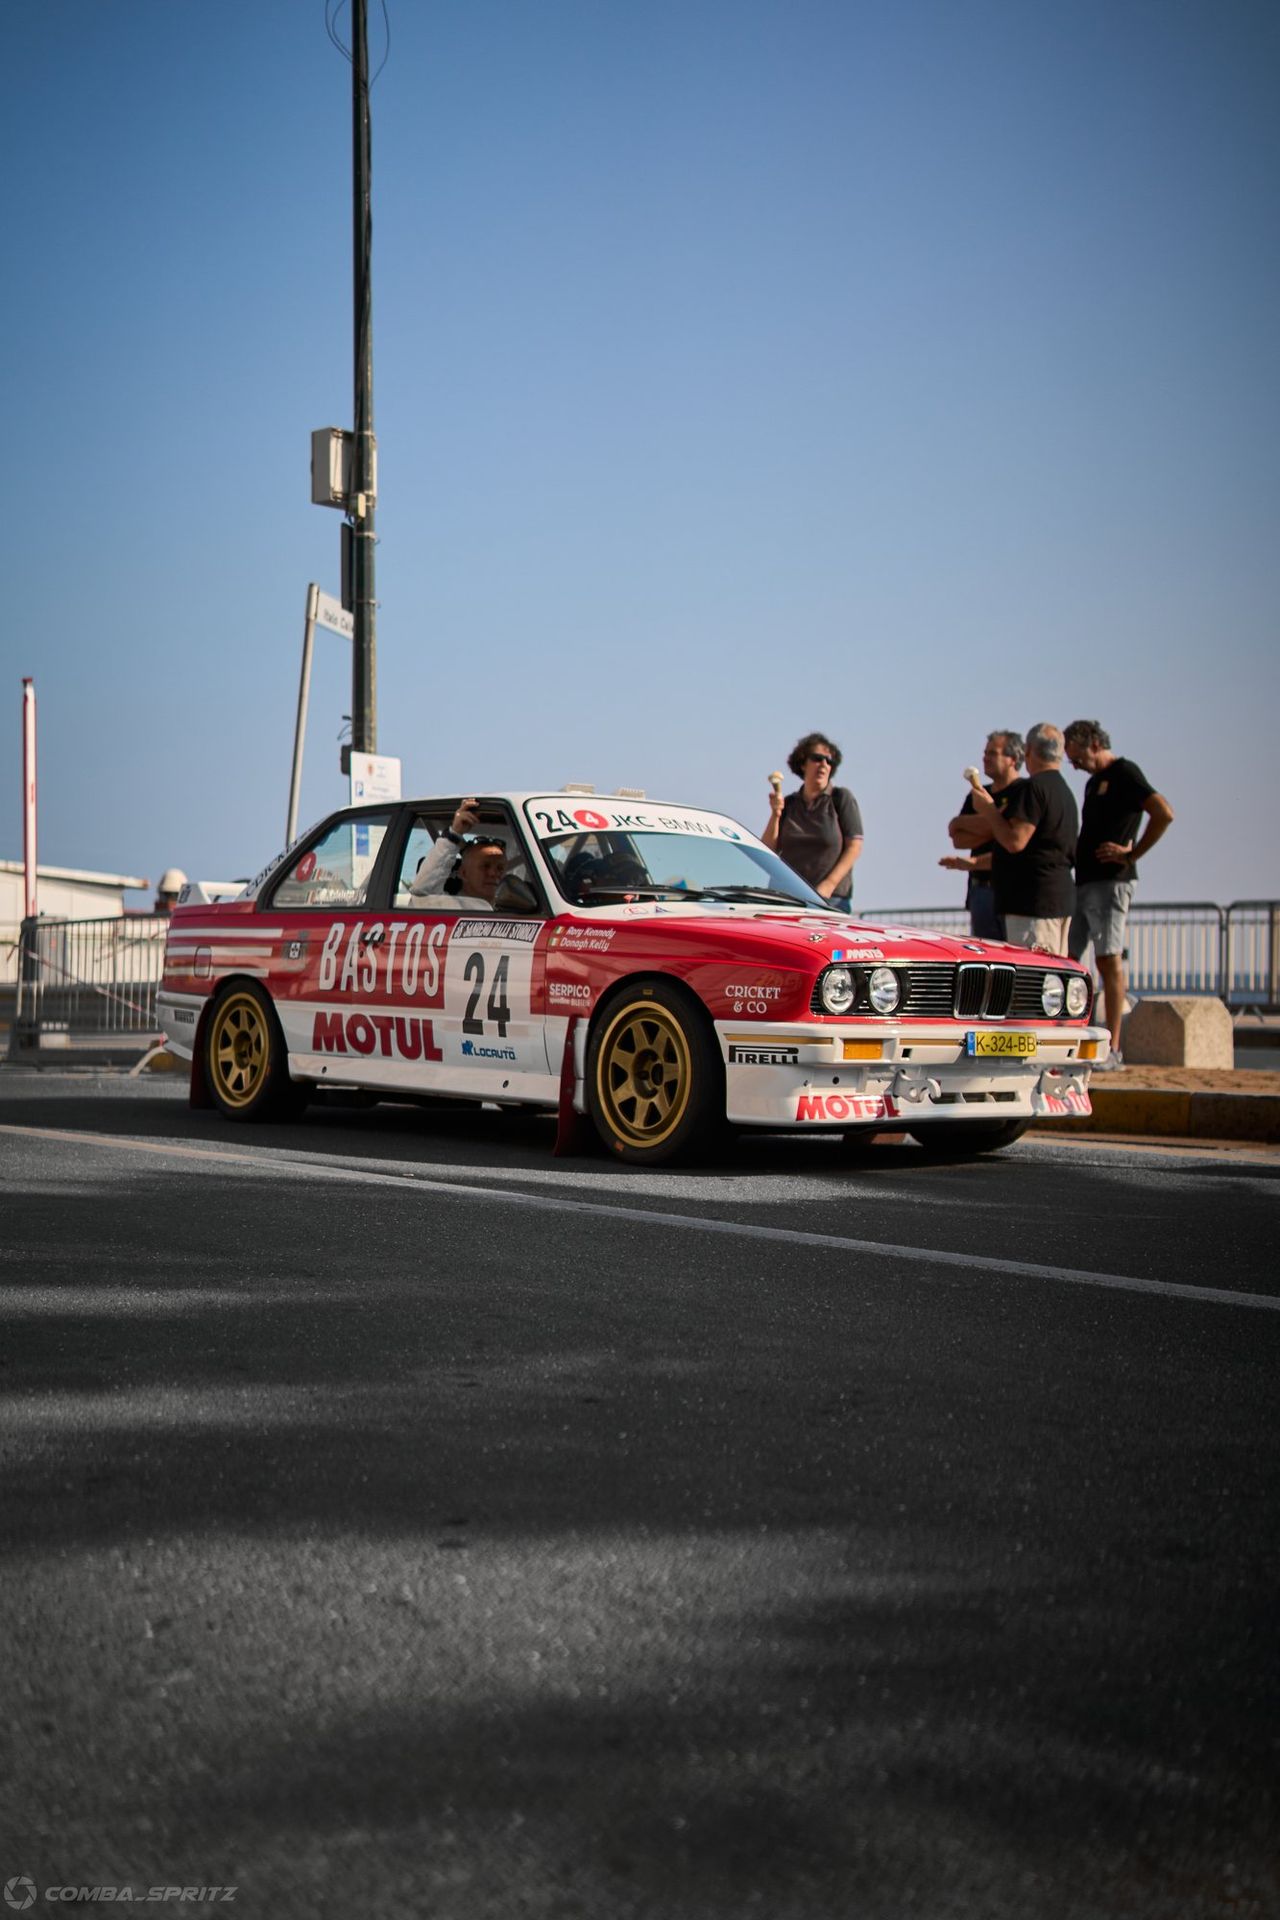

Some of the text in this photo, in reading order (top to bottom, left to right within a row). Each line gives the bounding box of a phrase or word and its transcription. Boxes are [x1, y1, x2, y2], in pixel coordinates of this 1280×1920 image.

[535, 810, 714, 835] 24 4 JKC BMW
[301, 858, 312, 875] 4
[566, 926, 616, 939] Rory Kennedy
[560, 937, 610, 953] Donagh Kelly
[319, 922, 447, 997] BASTOS
[462, 952, 511, 1038] 24
[550, 983, 591, 997] SERPICO
[725, 985, 781, 999] CRICKET
[733, 1001, 767, 1014] & CO
[312, 1011, 443, 1062] MOTUL
[976, 1034, 1036, 1053] K-324-BB
[728, 1045, 799, 1065] PIRELLI
[795, 1094, 901, 1122] MOTUL
